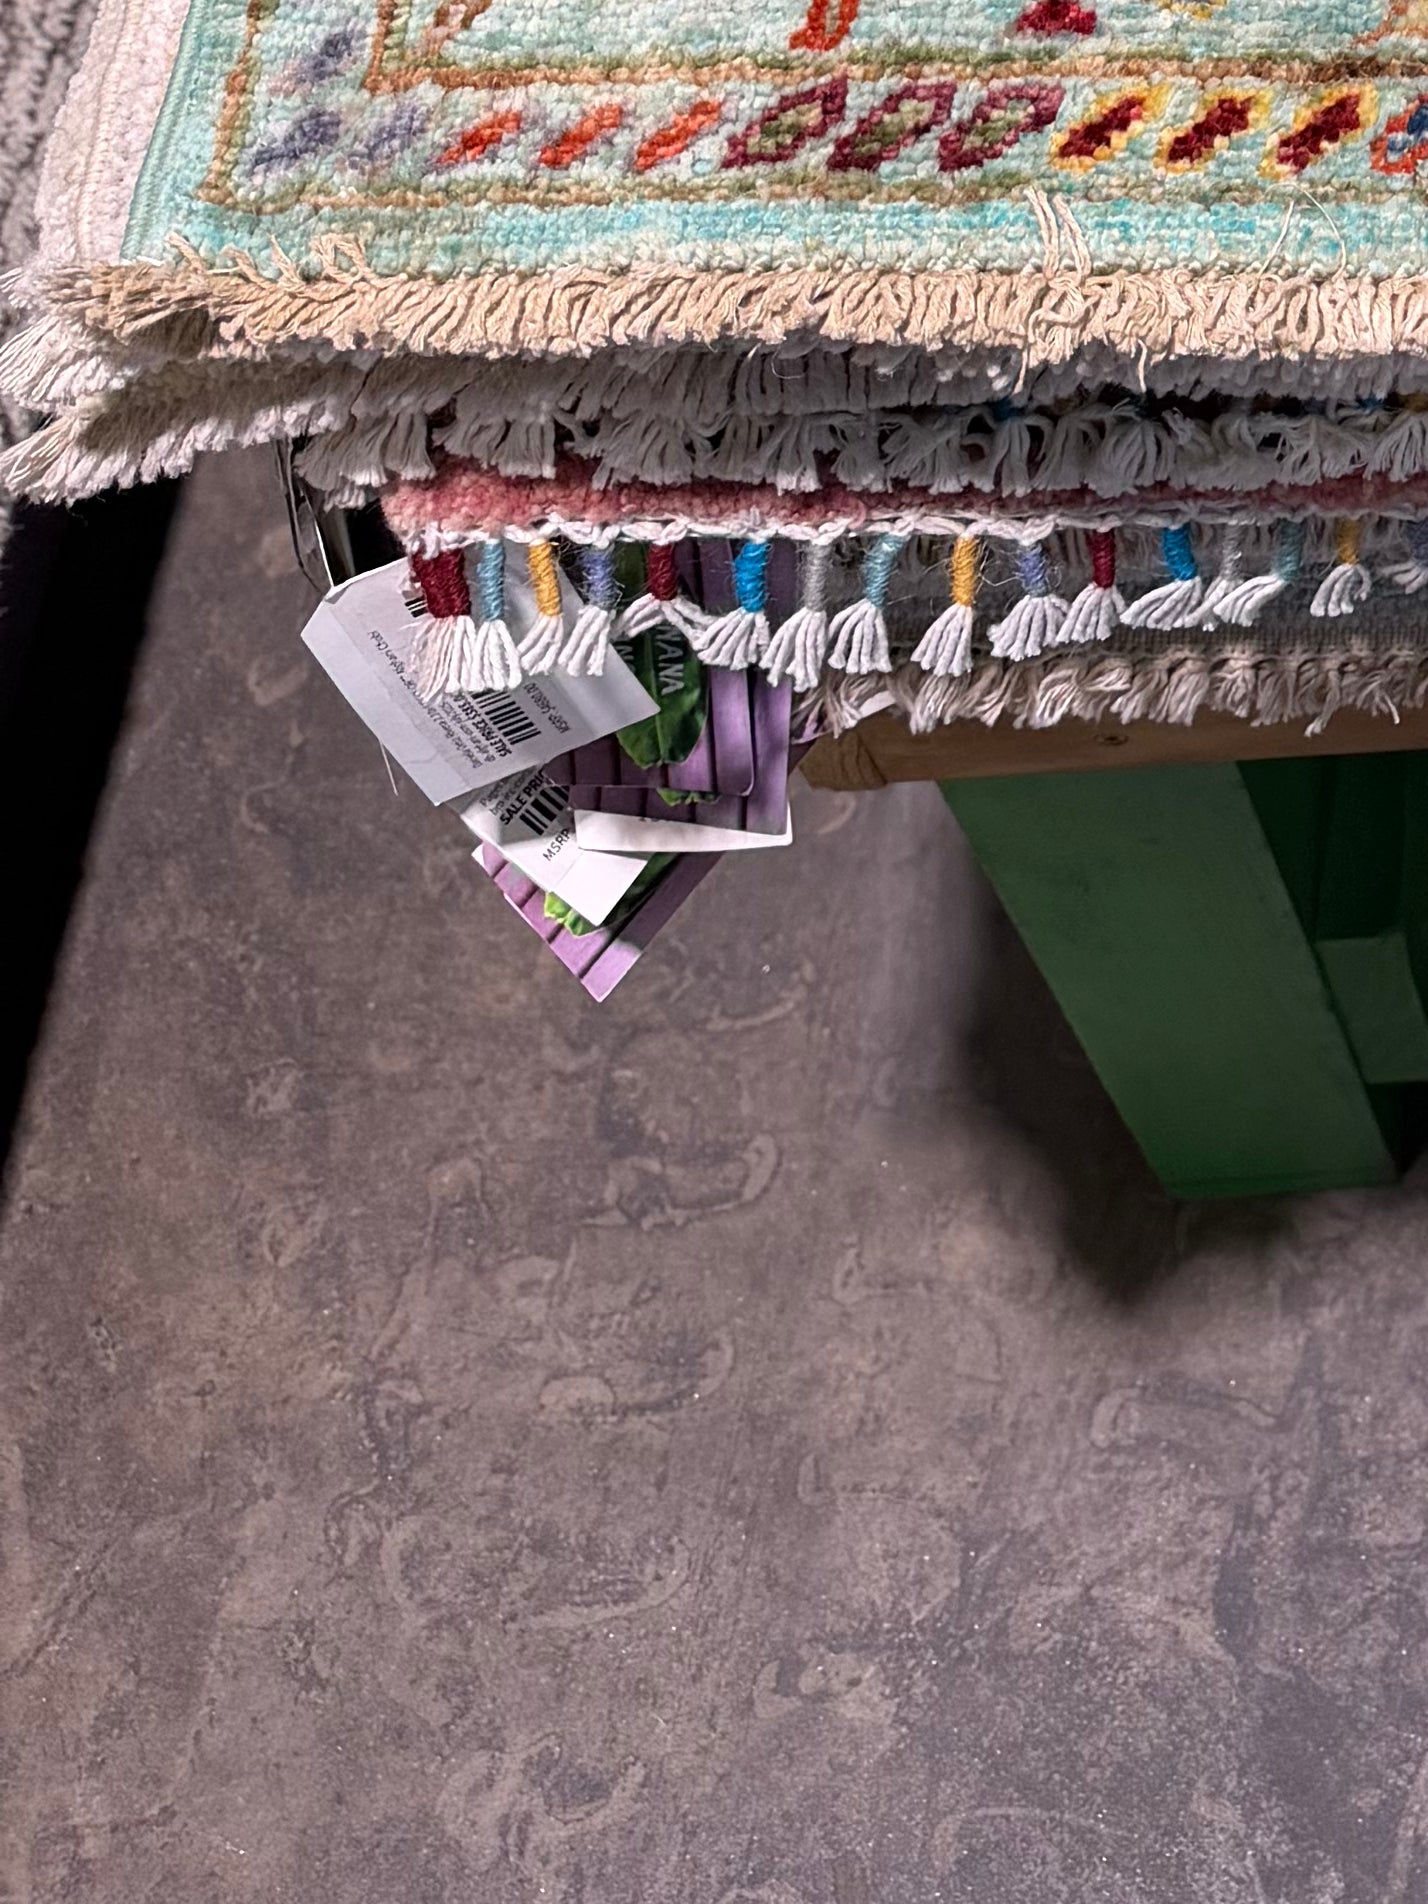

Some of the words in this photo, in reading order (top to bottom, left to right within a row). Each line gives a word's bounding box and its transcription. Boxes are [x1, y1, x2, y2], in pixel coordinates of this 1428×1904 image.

[471, 717, 497, 741] PRICE
[488, 738, 512, 757] SALE
[499, 794, 527, 826] SALE
[522, 771, 546, 797] PRI
[542, 827, 572, 861] MSRP
